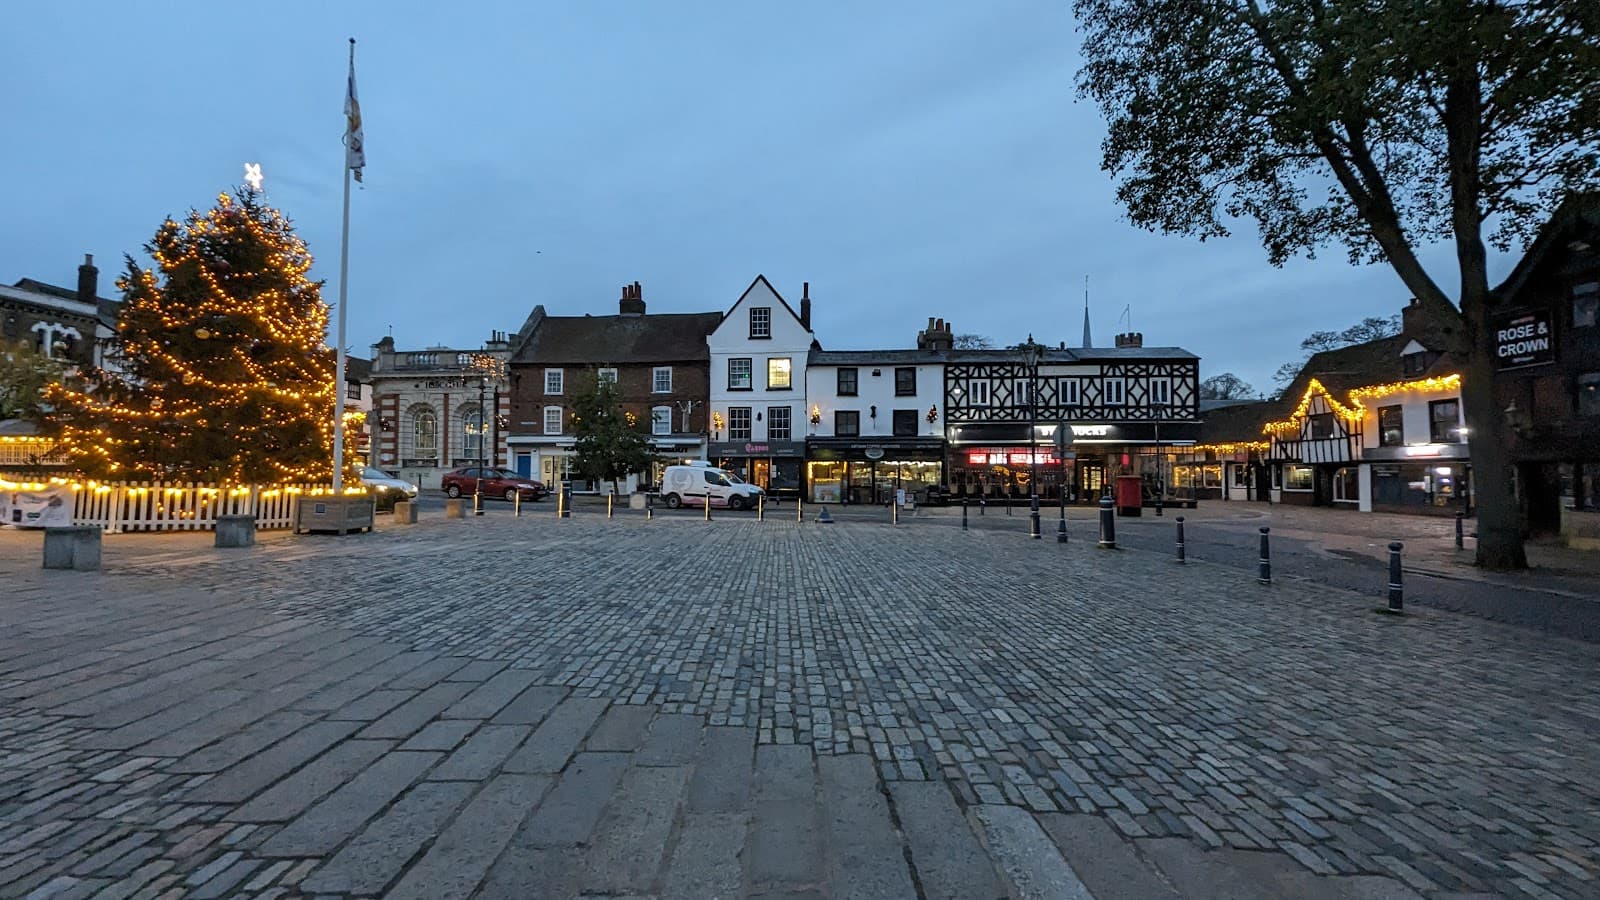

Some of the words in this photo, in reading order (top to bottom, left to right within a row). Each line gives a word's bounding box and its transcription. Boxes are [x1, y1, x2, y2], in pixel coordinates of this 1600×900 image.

[1498, 324, 1535, 342] ROSE
[1537, 321, 1548, 335] &
[1498, 337, 1549, 357] CROWN
